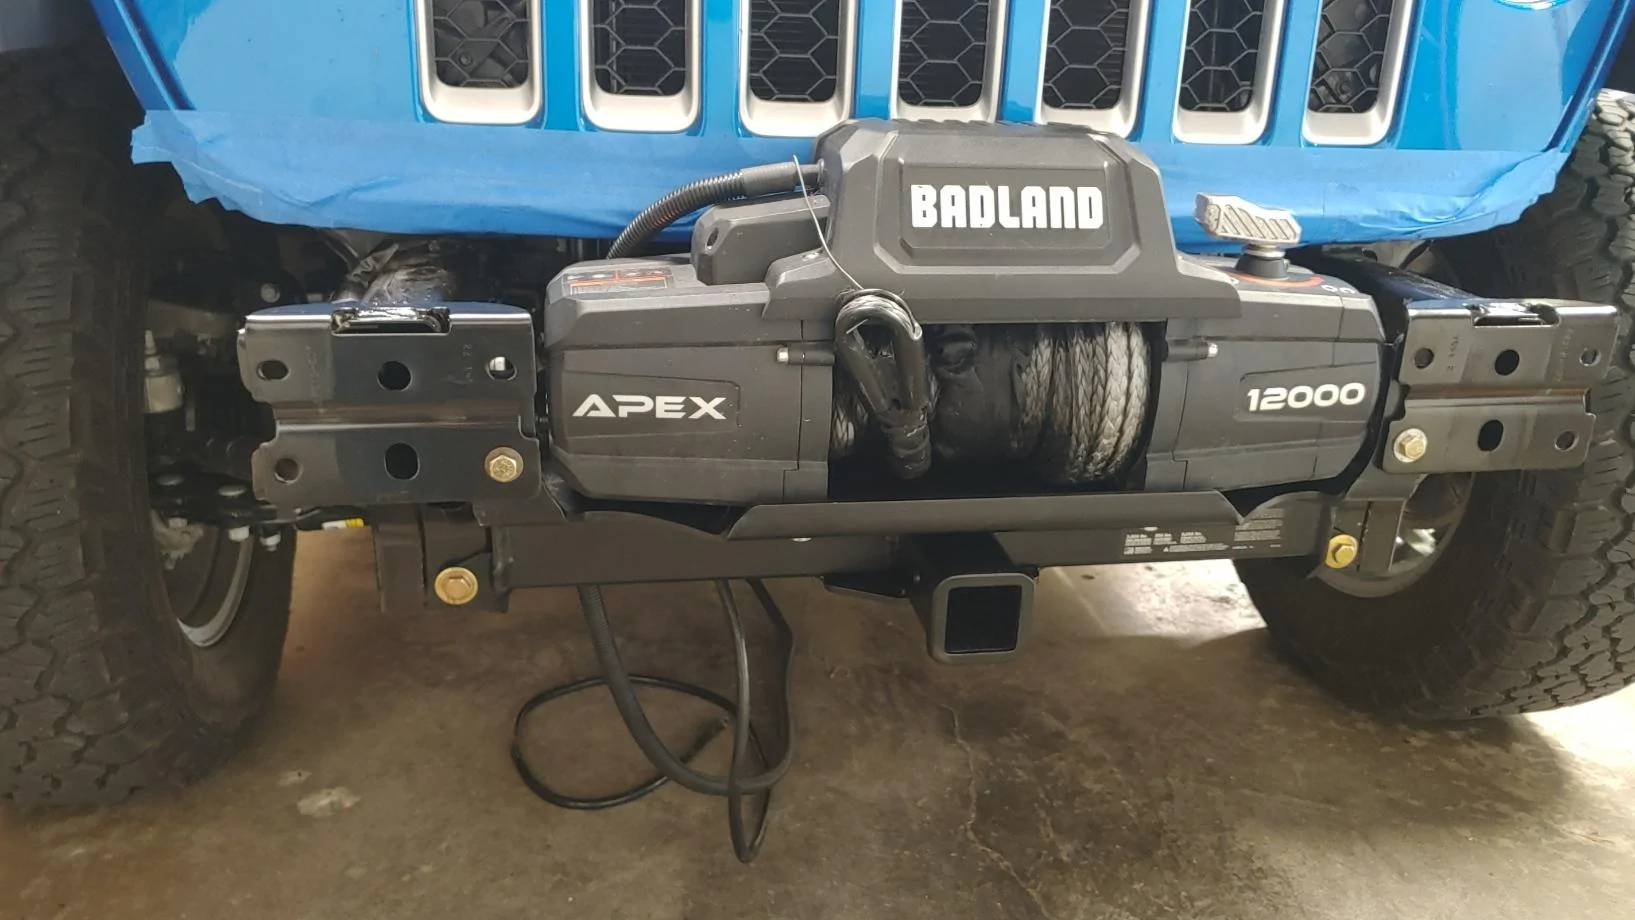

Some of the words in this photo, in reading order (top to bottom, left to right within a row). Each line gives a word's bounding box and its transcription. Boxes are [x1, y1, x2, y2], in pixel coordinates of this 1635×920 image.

[911, 184, 1104, 229] BADLAND
[572, 394, 727, 420] APEX
[1247, 382, 1366, 412] 12000
